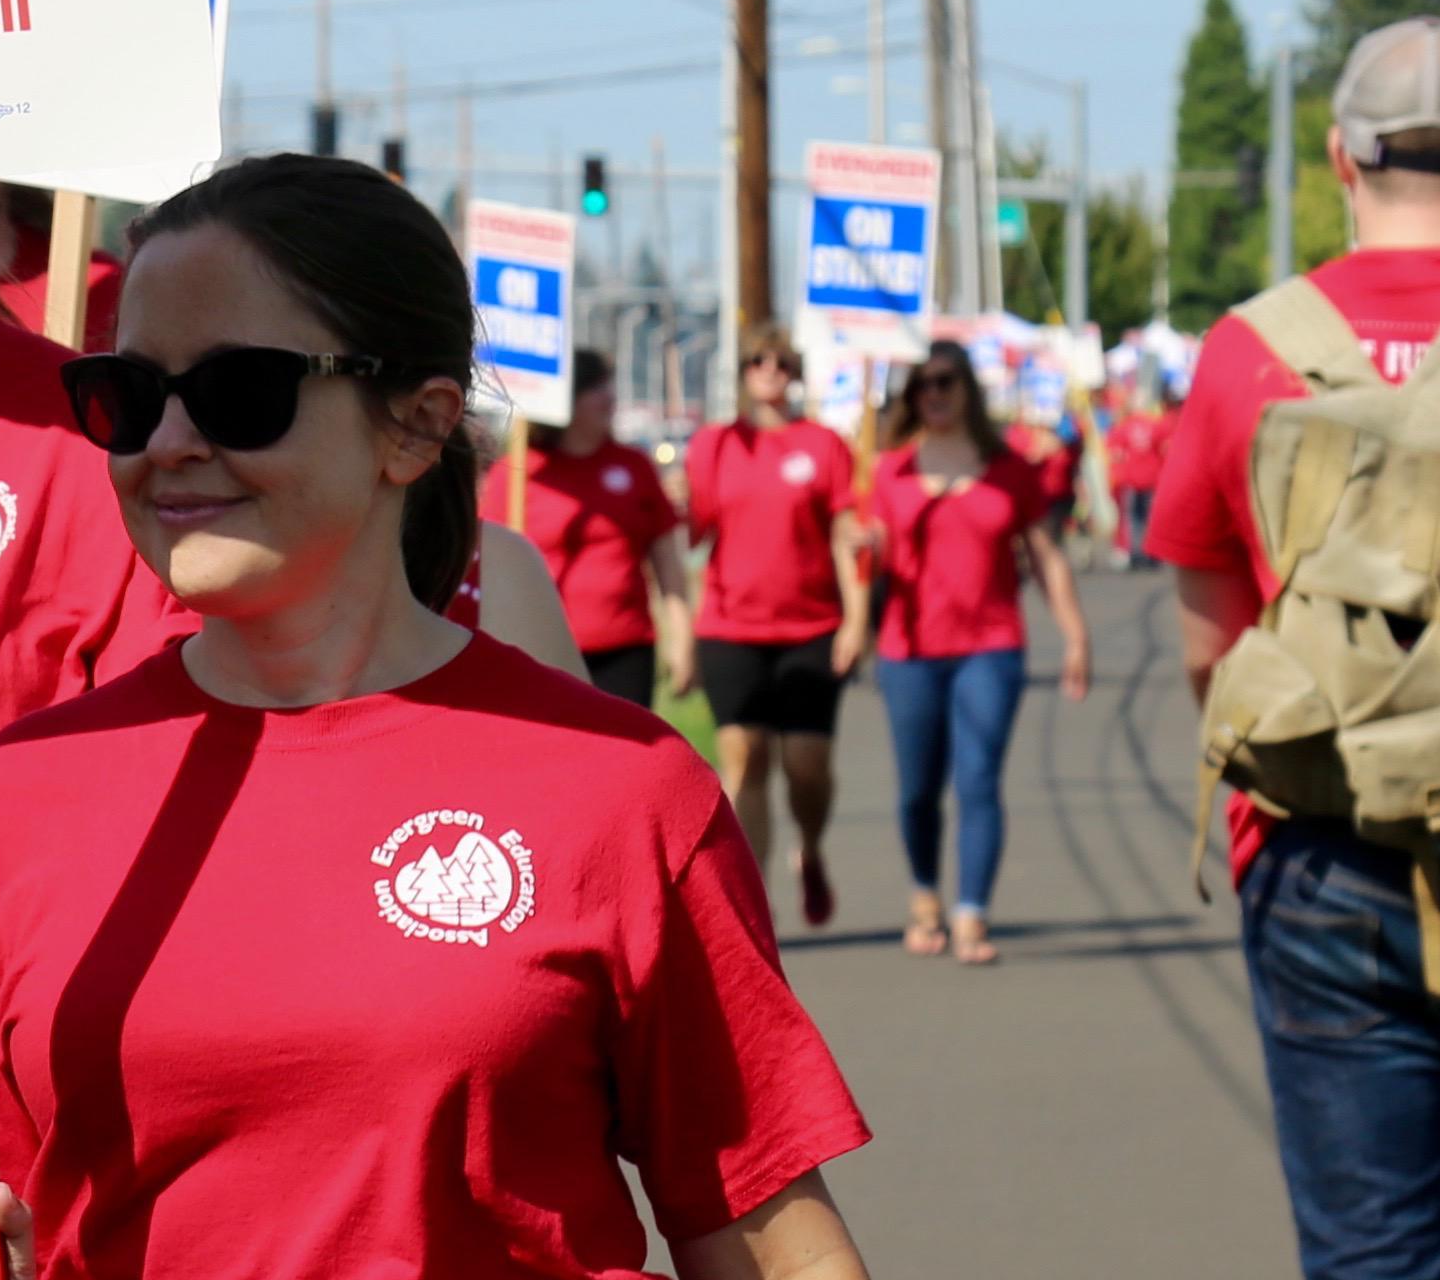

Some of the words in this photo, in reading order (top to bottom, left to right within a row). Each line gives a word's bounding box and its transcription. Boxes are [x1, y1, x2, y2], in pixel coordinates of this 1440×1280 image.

[843, 205, 894, 248] ON
[370, 808, 484, 868] Evergreen
[498, 828, 536, 934] Education
[374, 879, 489, 948] Association
